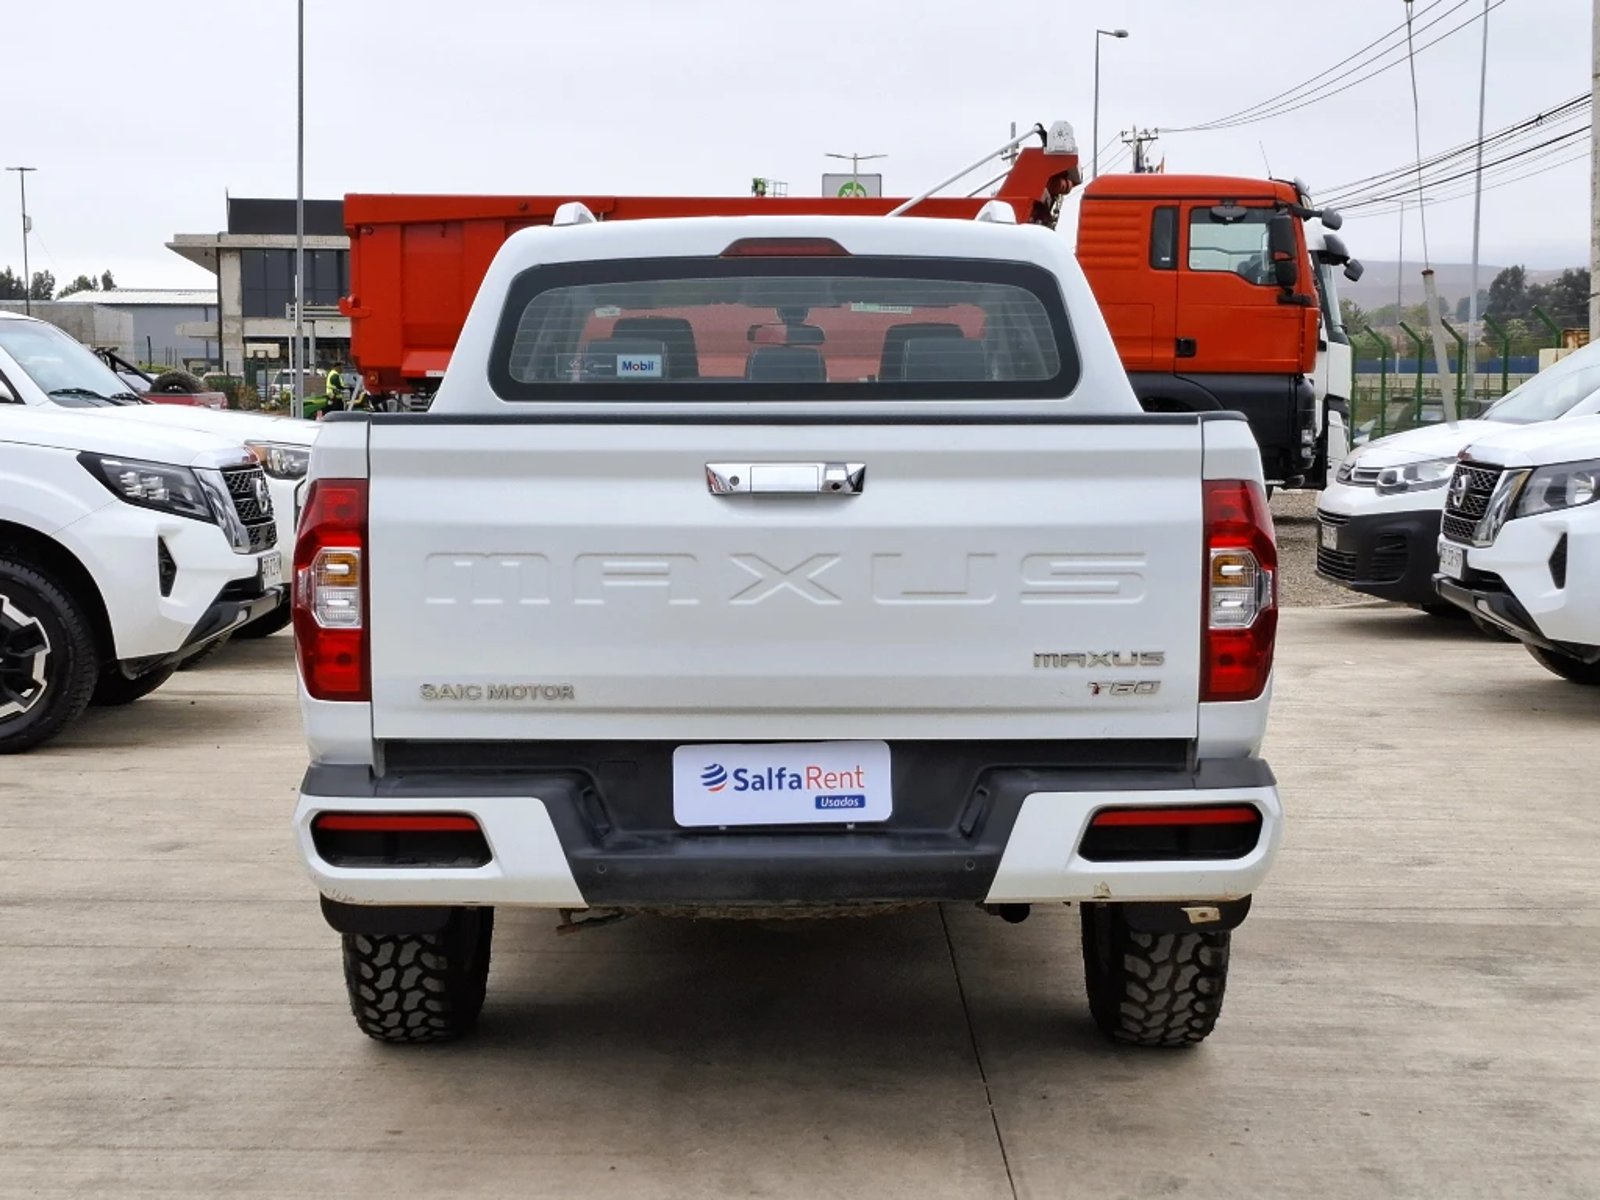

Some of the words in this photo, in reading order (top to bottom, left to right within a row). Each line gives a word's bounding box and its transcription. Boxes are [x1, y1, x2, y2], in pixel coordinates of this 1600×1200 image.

[622, 361, 654, 371] Mobil
[424, 552, 1148, 606] MAXUS
[1033, 651, 1166, 668] MAXUS
[419, 682, 483, 701] SAIC
[487, 682, 576, 701] MOTOR
[1087, 679, 1162, 696] T60
[732, 764, 865, 792] SalfaRent
[820, 796, 860, 809] Usados
